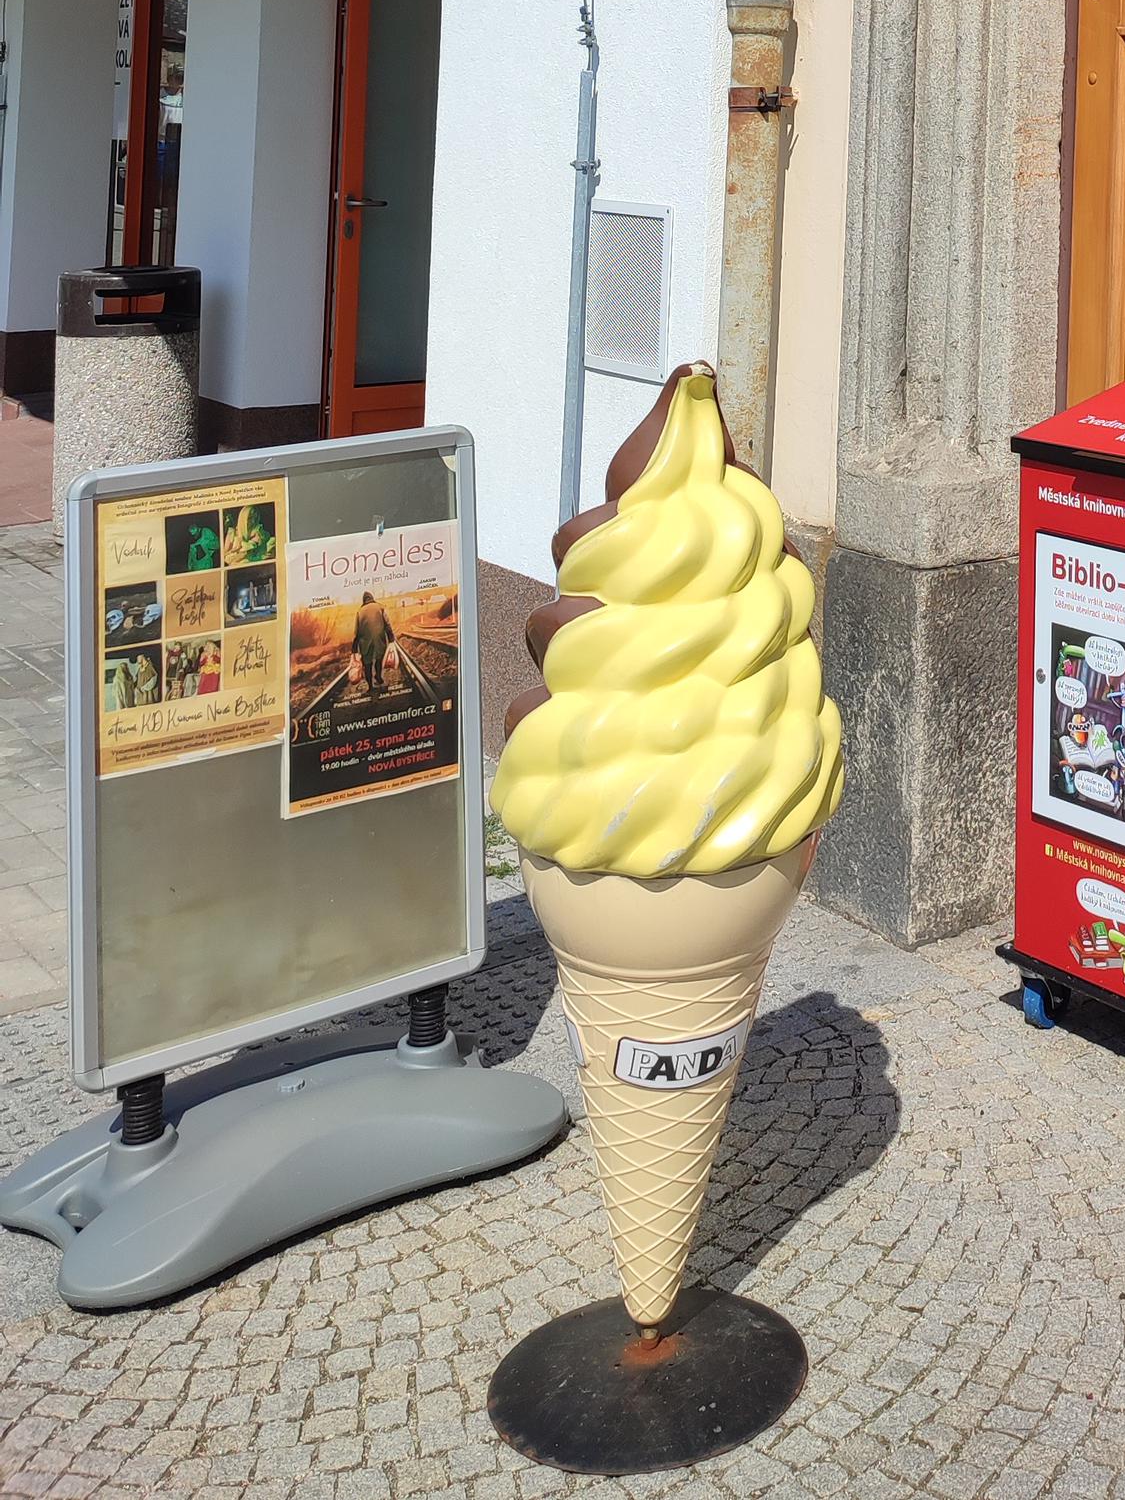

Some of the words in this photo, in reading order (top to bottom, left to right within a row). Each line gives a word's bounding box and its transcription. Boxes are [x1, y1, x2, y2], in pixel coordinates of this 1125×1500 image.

[1038, 486, 1081, 509] Městská
[304, 533, 444, 581] Homeless
[343, 577, 362, 588] Život
[363, 576, 371, 587] je
[371, 575, 383, 586] jen
[384, 570, 409, 583] náhoda
[336, 704, 437, 734] www.semtamfor.cz
[319, 743, 353, 763] pátek
[356, 738, 374, 751] 25.
[376, 733, 405, 748] srpna
[407, 723, 435, 739] 2023
[320, 761, 340, 773] 19.00
[341, 757, 360, 768] hodin
[368, 760, 396, 774] NOVÁ
[396, 750, 436, 769] BYSTŘICE
[1055, 848, 1089, 870] Městská
[1090, 860, 1125, 884] knihovna
[628, 1035, 737, 1081] PANDA
